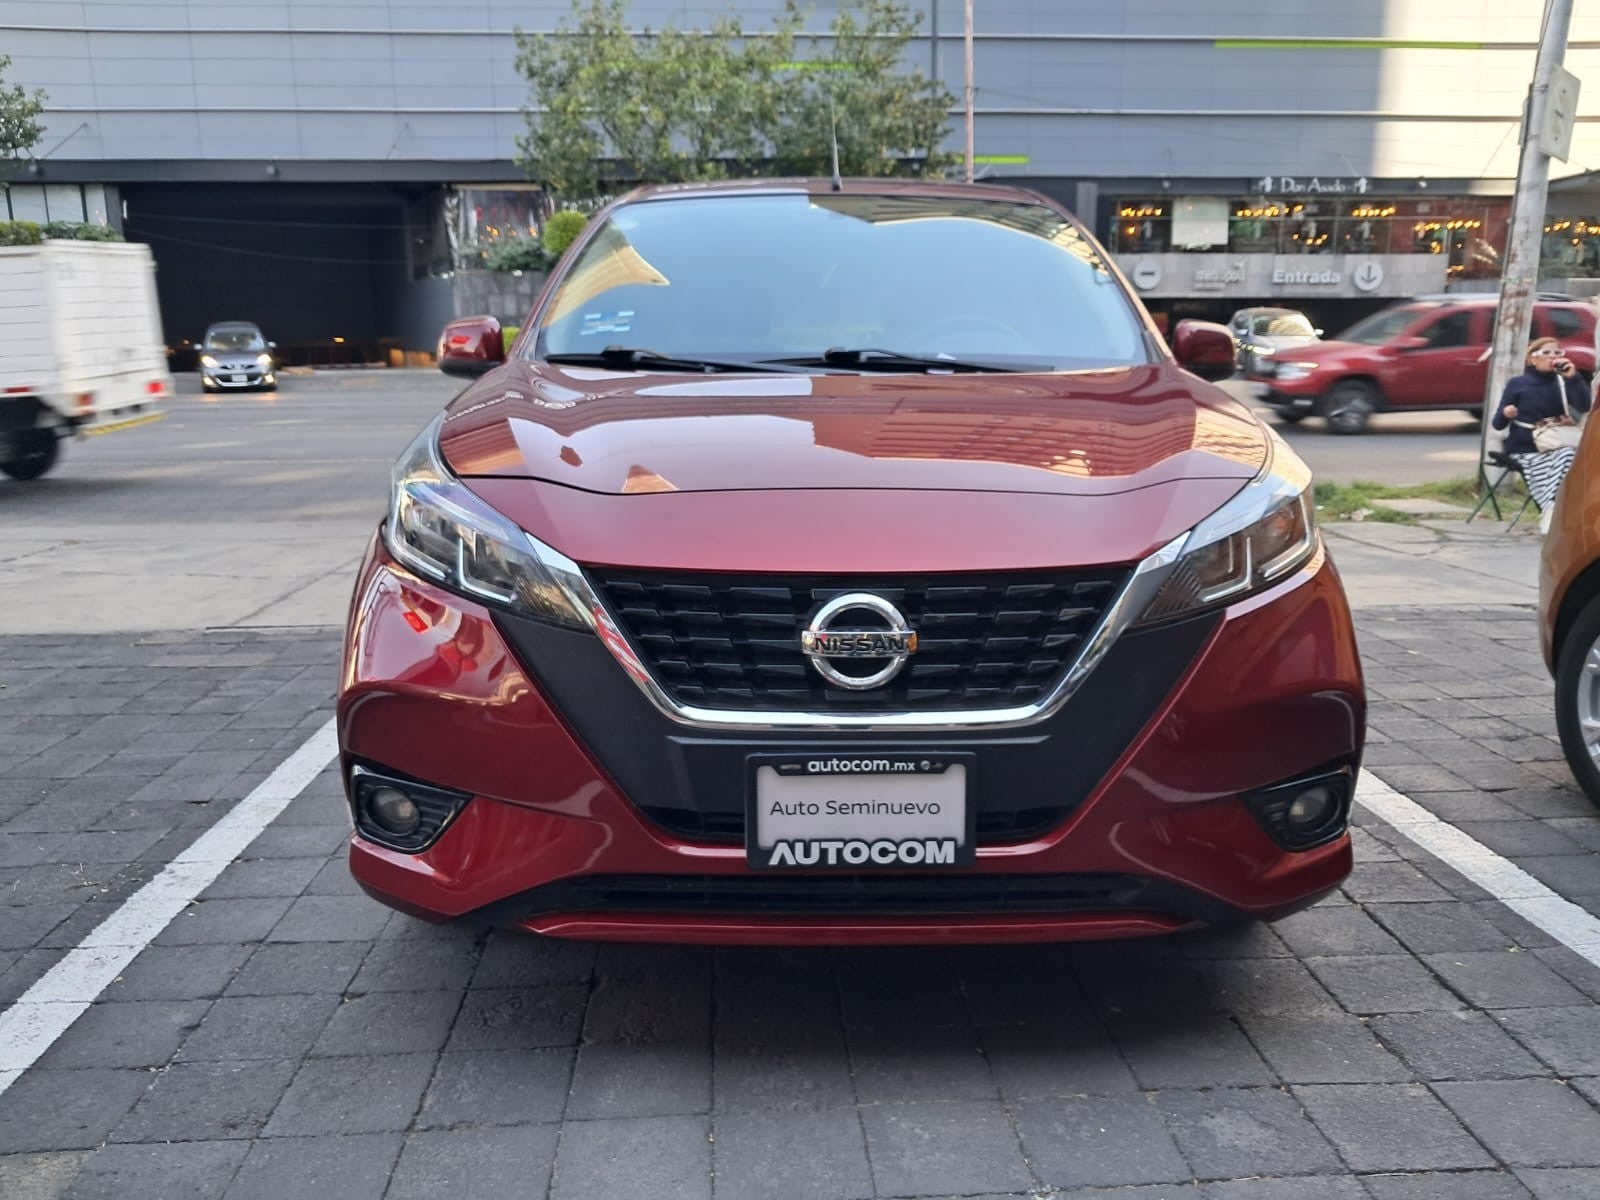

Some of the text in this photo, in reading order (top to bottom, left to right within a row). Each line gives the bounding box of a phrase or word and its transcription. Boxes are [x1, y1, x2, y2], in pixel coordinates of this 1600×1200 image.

[1273, 270, 1341, 284] Entrada
[815, 637, 905, 652] NISSAN
[807, 758, 916, 773] autocom.mx
[769, 800, 941, 816] Auto Seminuevo
[768, 841, 955, 865] AUTOCOM
